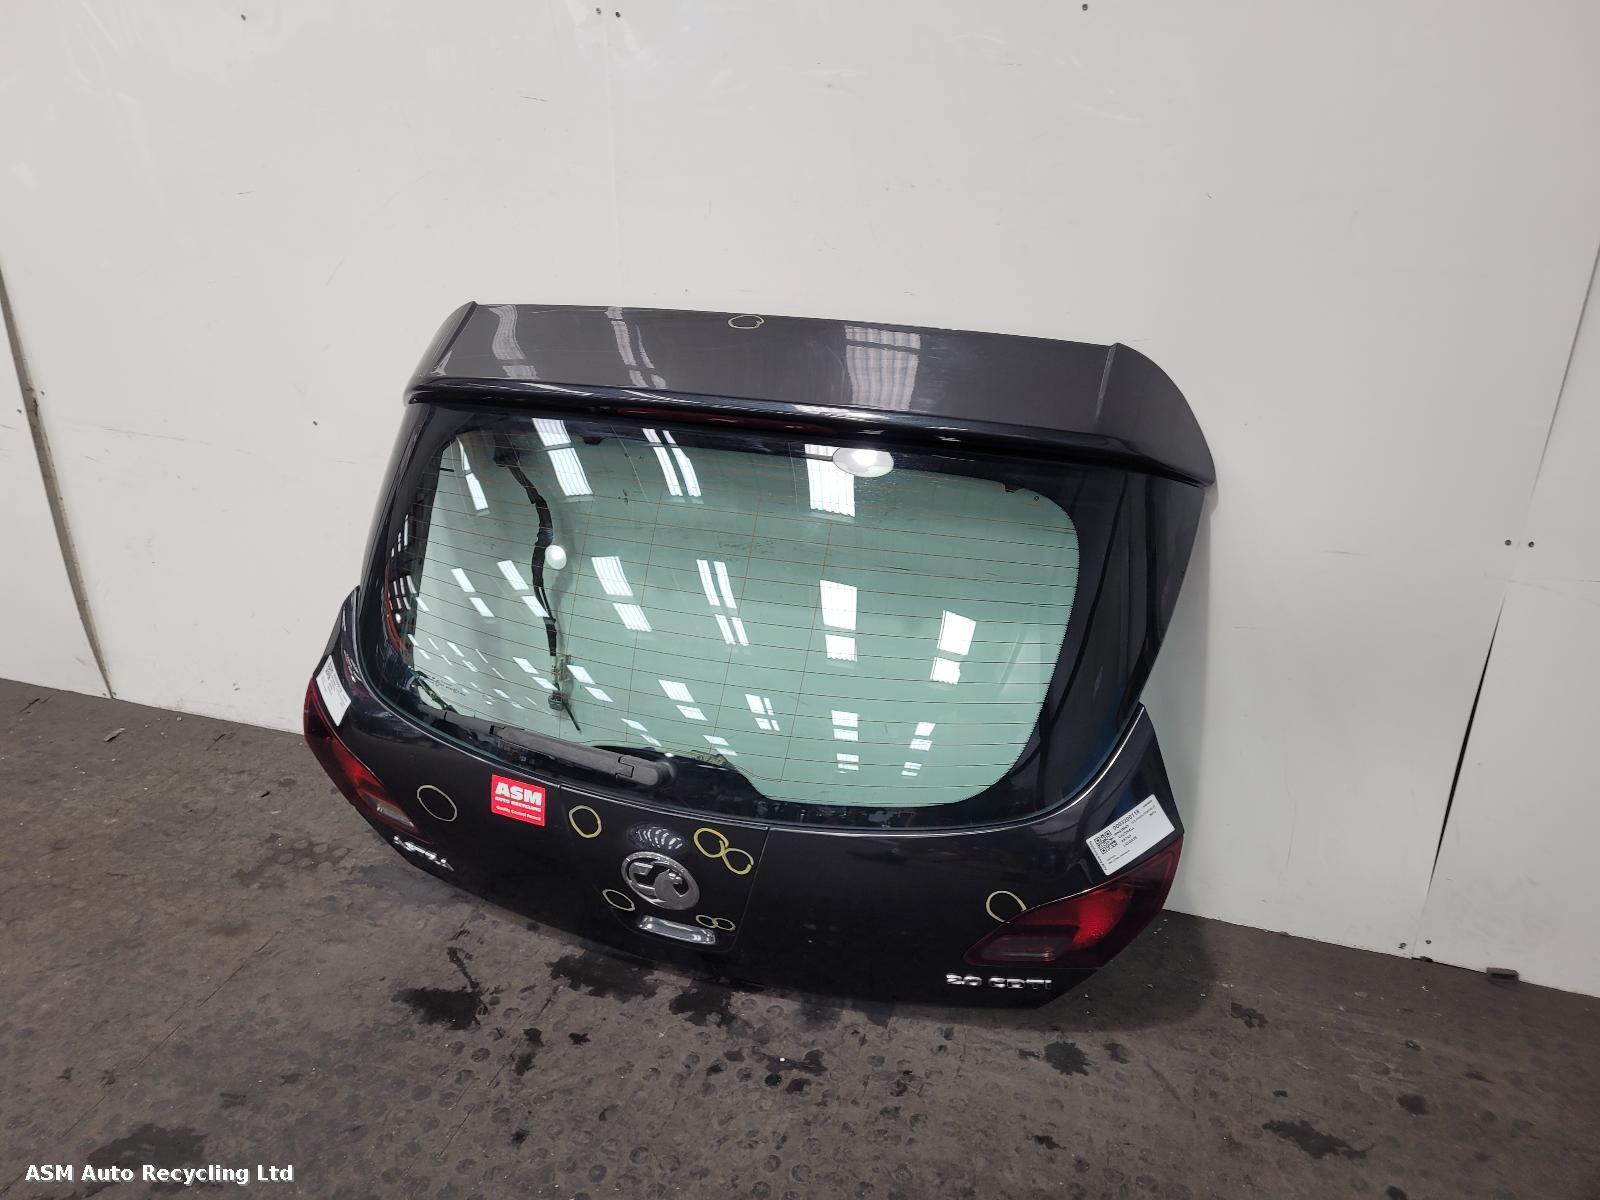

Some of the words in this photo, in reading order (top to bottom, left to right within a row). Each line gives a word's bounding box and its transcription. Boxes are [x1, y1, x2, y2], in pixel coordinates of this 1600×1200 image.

[494, 782, 542, 806] ASM
[494, 796, 511, 804] AUTO
[510, 800, 542, 813] RECYCLING
